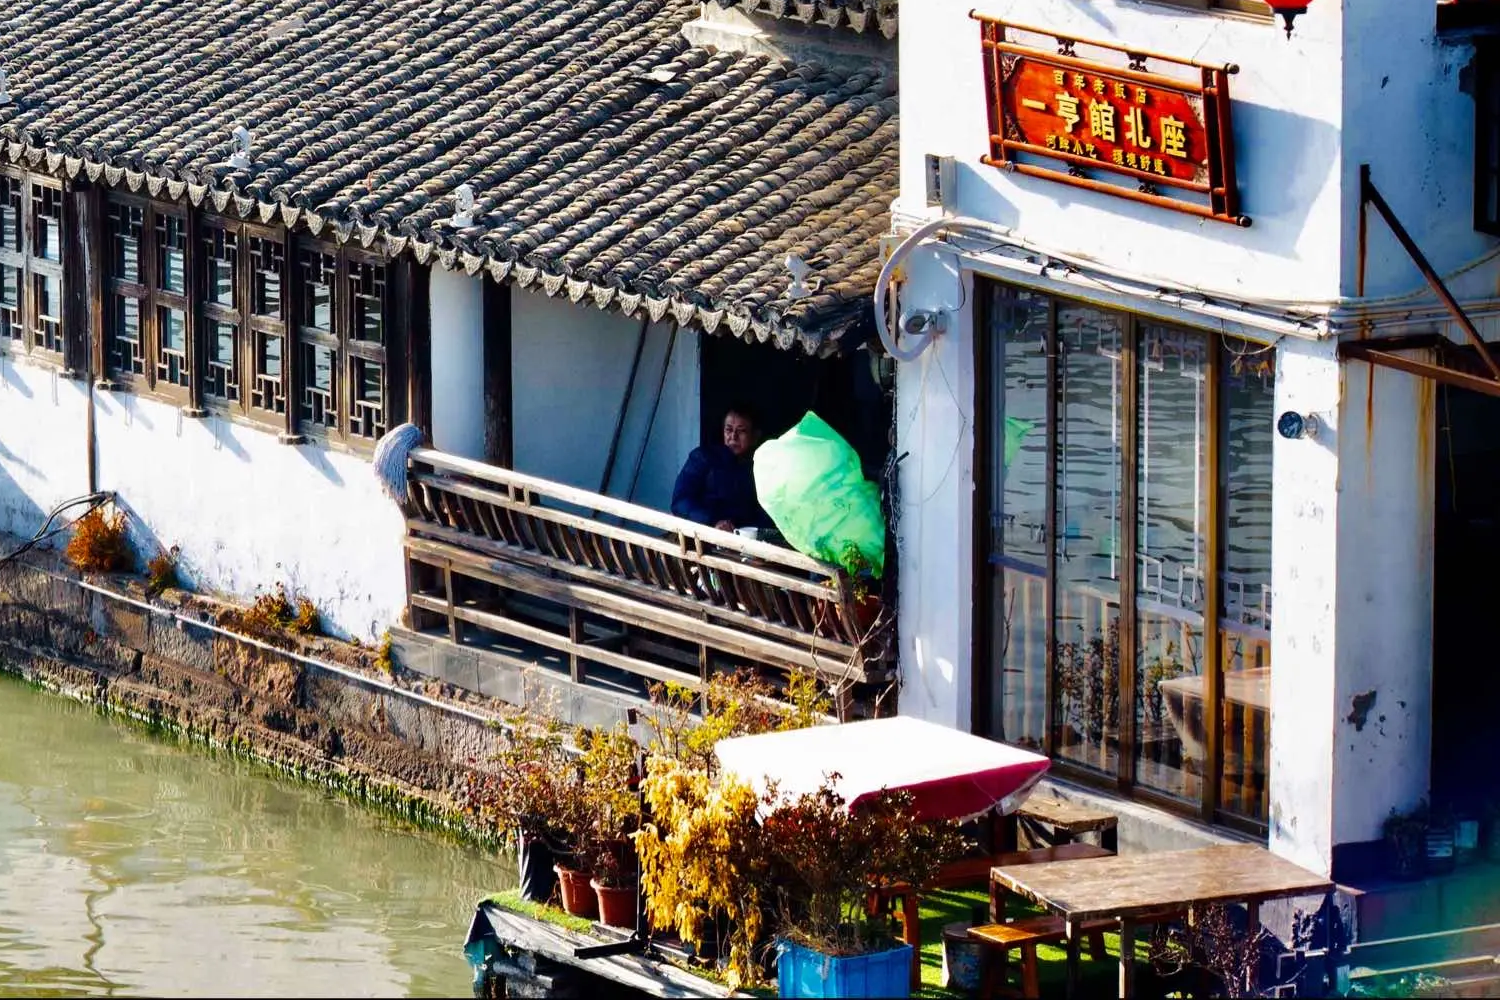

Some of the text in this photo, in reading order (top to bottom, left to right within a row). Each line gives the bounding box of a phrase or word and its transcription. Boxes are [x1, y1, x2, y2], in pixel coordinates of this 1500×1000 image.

[1052, 69, 1147, 104] 百年老飯店
[1021, 91, 1188, 158] 一亨館北座
